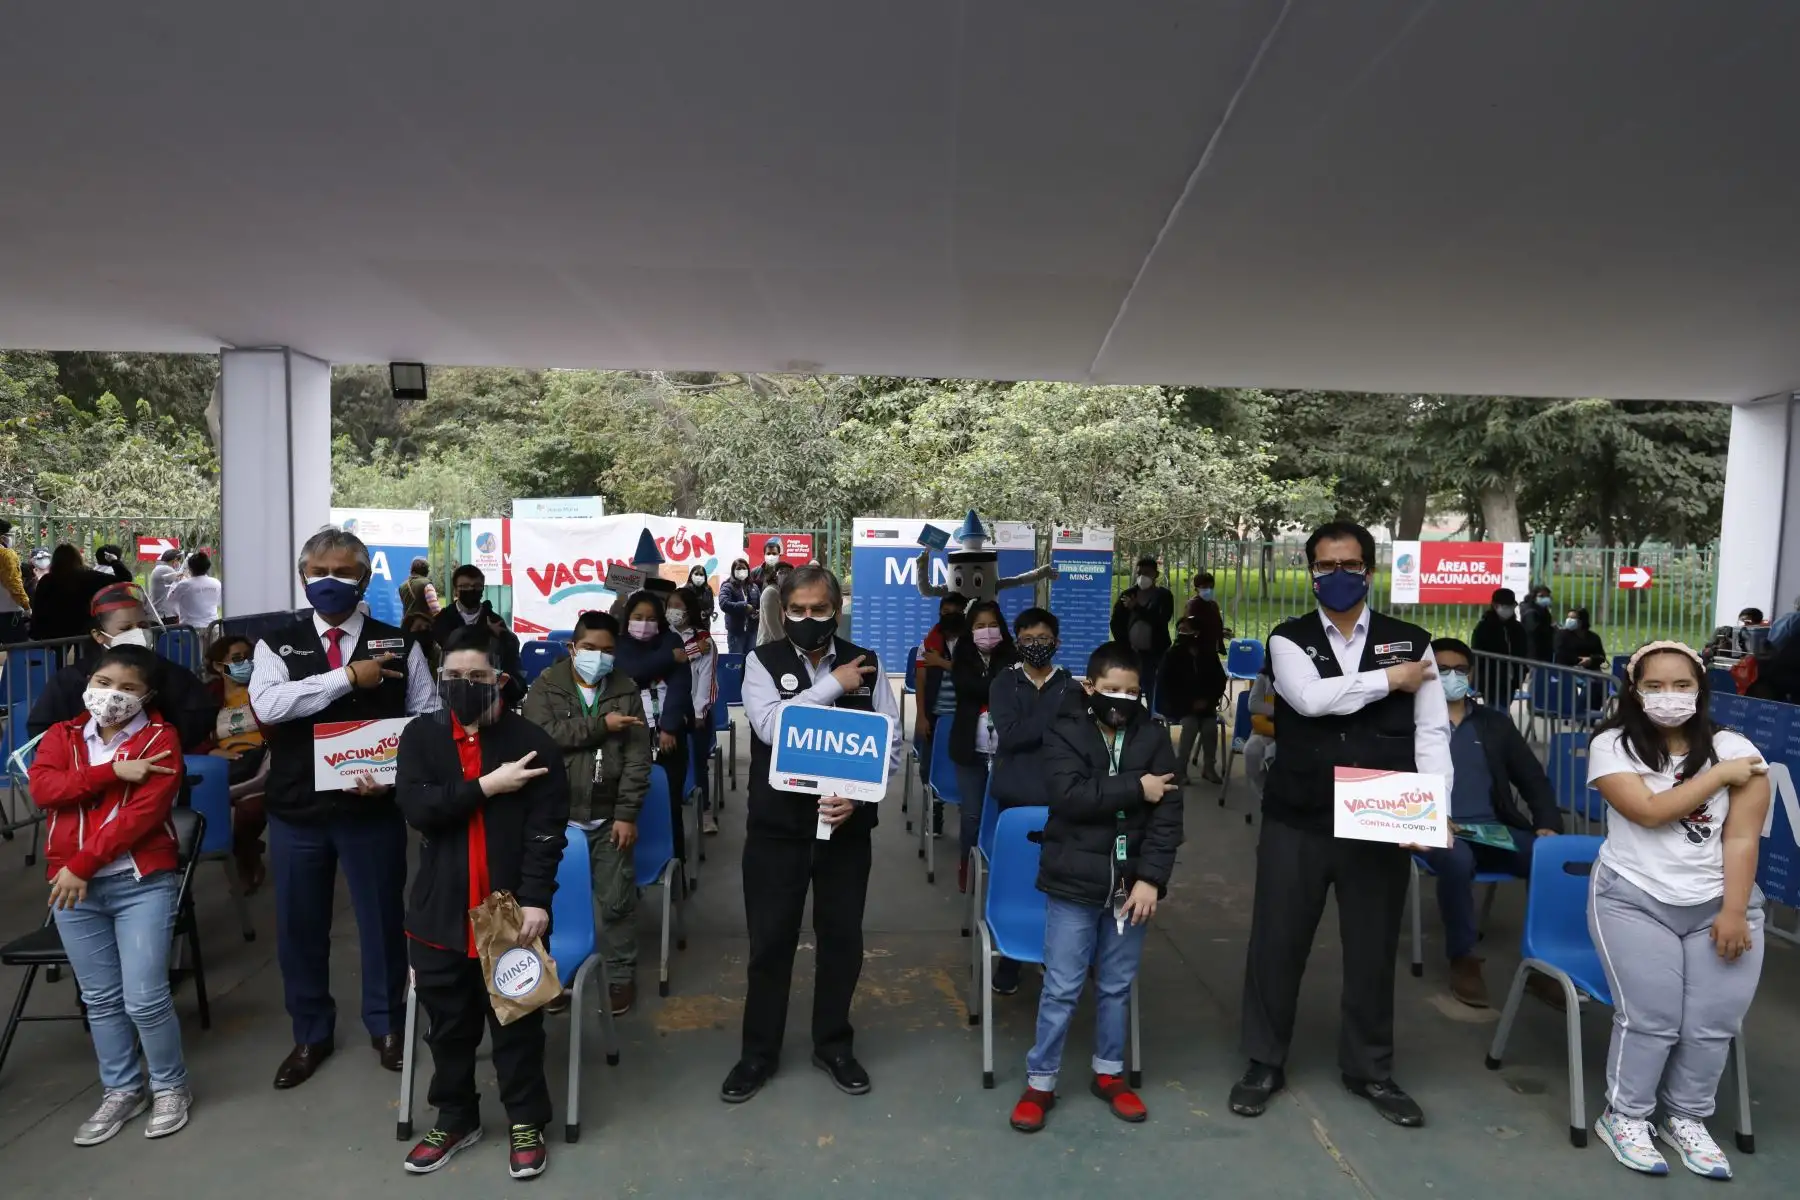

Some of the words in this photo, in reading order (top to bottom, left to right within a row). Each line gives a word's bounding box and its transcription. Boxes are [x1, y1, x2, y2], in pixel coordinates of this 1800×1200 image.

[1059, 564, 1077, 572] Lima
[1080, 564, 1105, 573] Centro
[1437, 559, 1467, 572] ÁREA
[1470, 562, 1486, 572] DE
[1420, 571, 1501, 584] VACUNACIÓN
[786, 726, 878, 758] MINSA
[324, 733, 401, 767] VACUNATÓ
[340, 768, 368, 776] CONTRA
[1344, 788, 1434, 813] VACUNATÓN
[1360, 820, 1390, 828] CONTRA
[1402, 823, 1437, 832] COVID-19
[496, 955, 536, 987] MINSA
